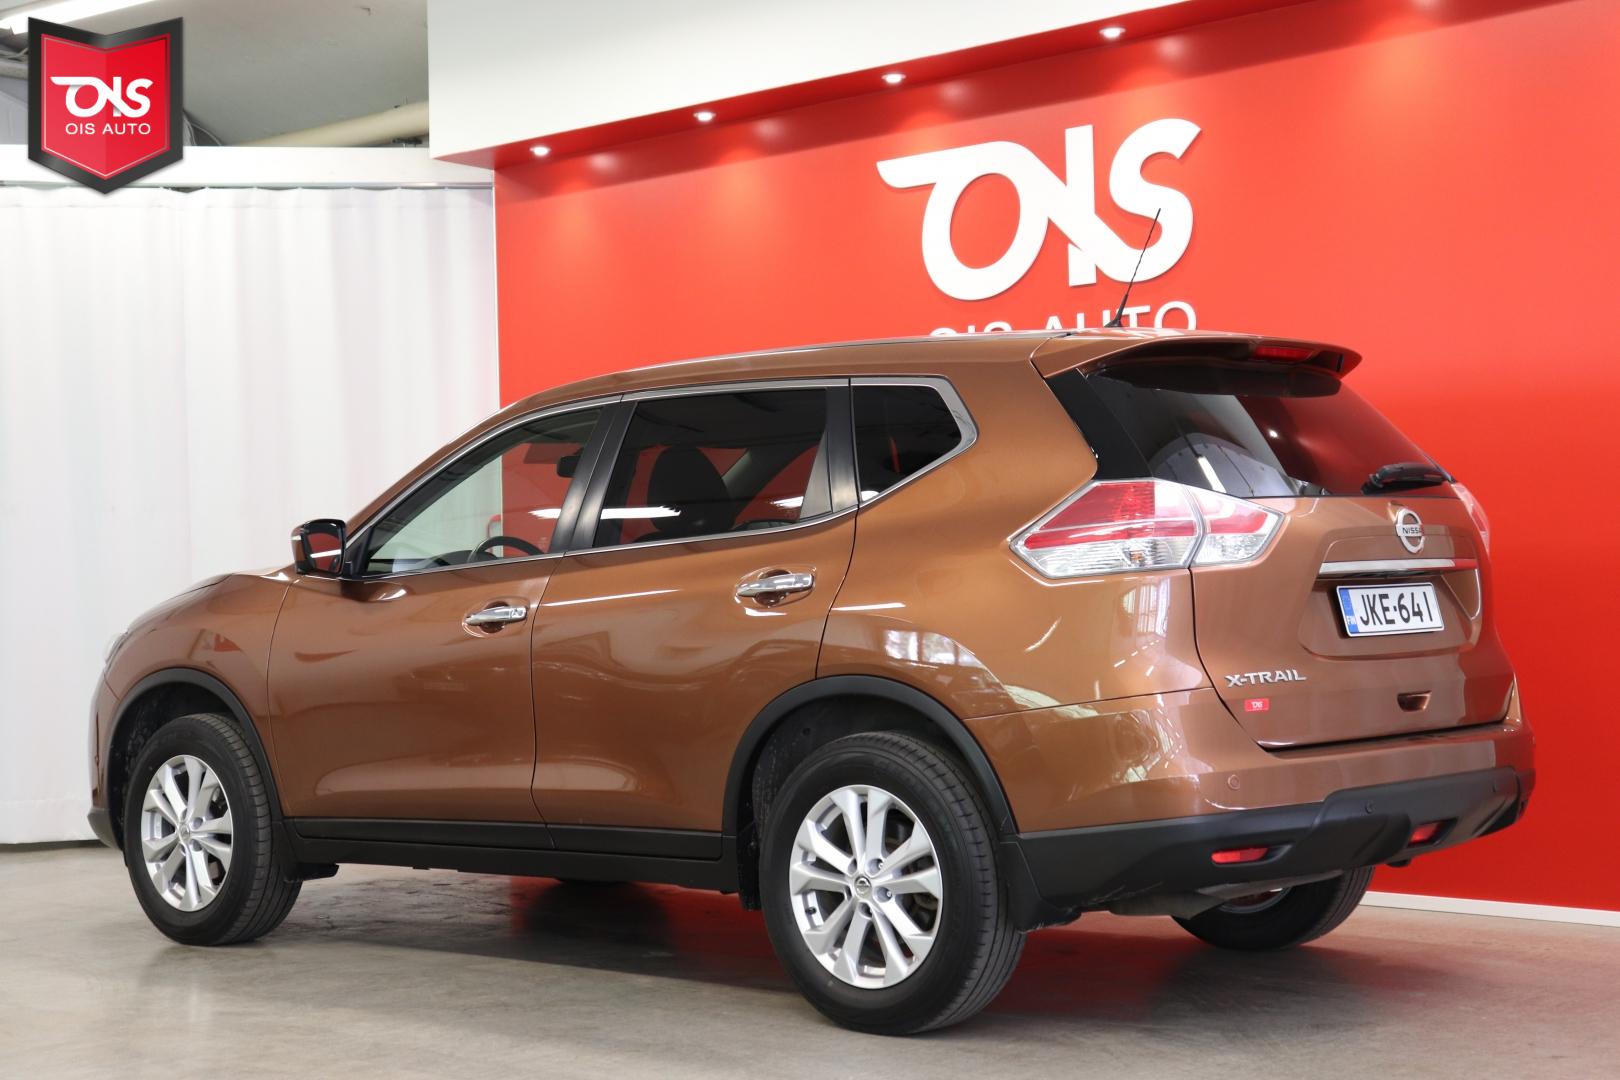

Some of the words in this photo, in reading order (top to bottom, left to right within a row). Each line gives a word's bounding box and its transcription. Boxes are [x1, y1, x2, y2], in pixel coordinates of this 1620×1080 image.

[876, 118, 1201, 301] OIS
[1360, 591, 1433, 626] JKE-641
[1225, 669, 1307, 688] X-TRAIL
